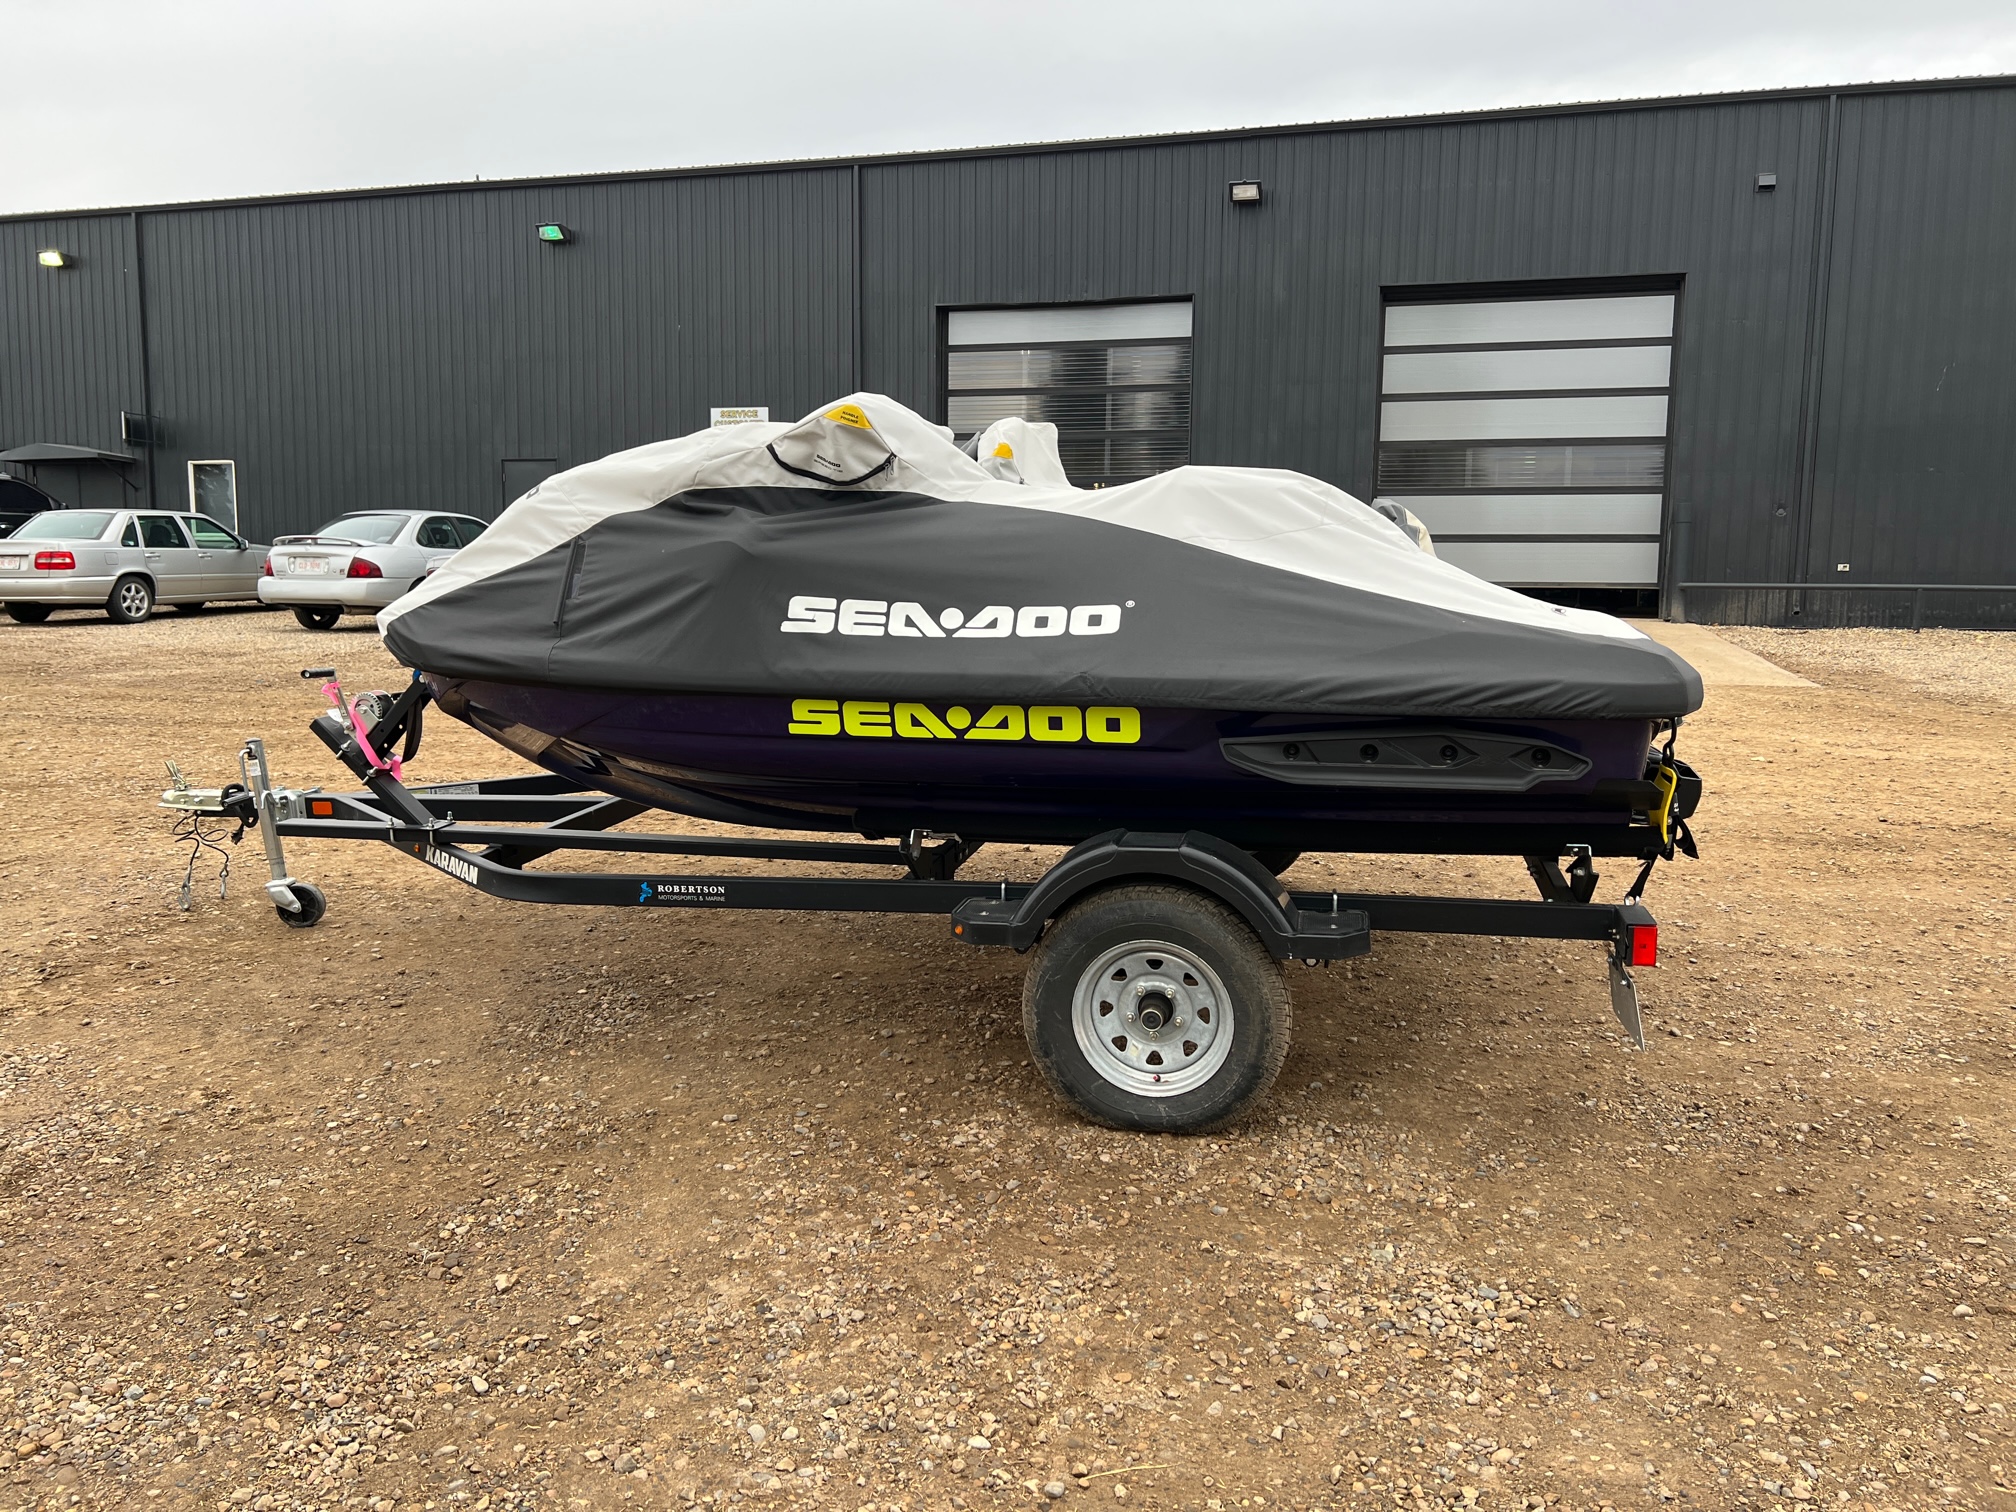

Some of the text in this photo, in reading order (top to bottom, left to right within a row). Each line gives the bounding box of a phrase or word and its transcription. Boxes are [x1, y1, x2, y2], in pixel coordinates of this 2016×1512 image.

[720, 409, 758, 418] SERVICE
[425, 844, 479, 885] KARAVAN
[657, 884, 725, 894] ROBERTSON
